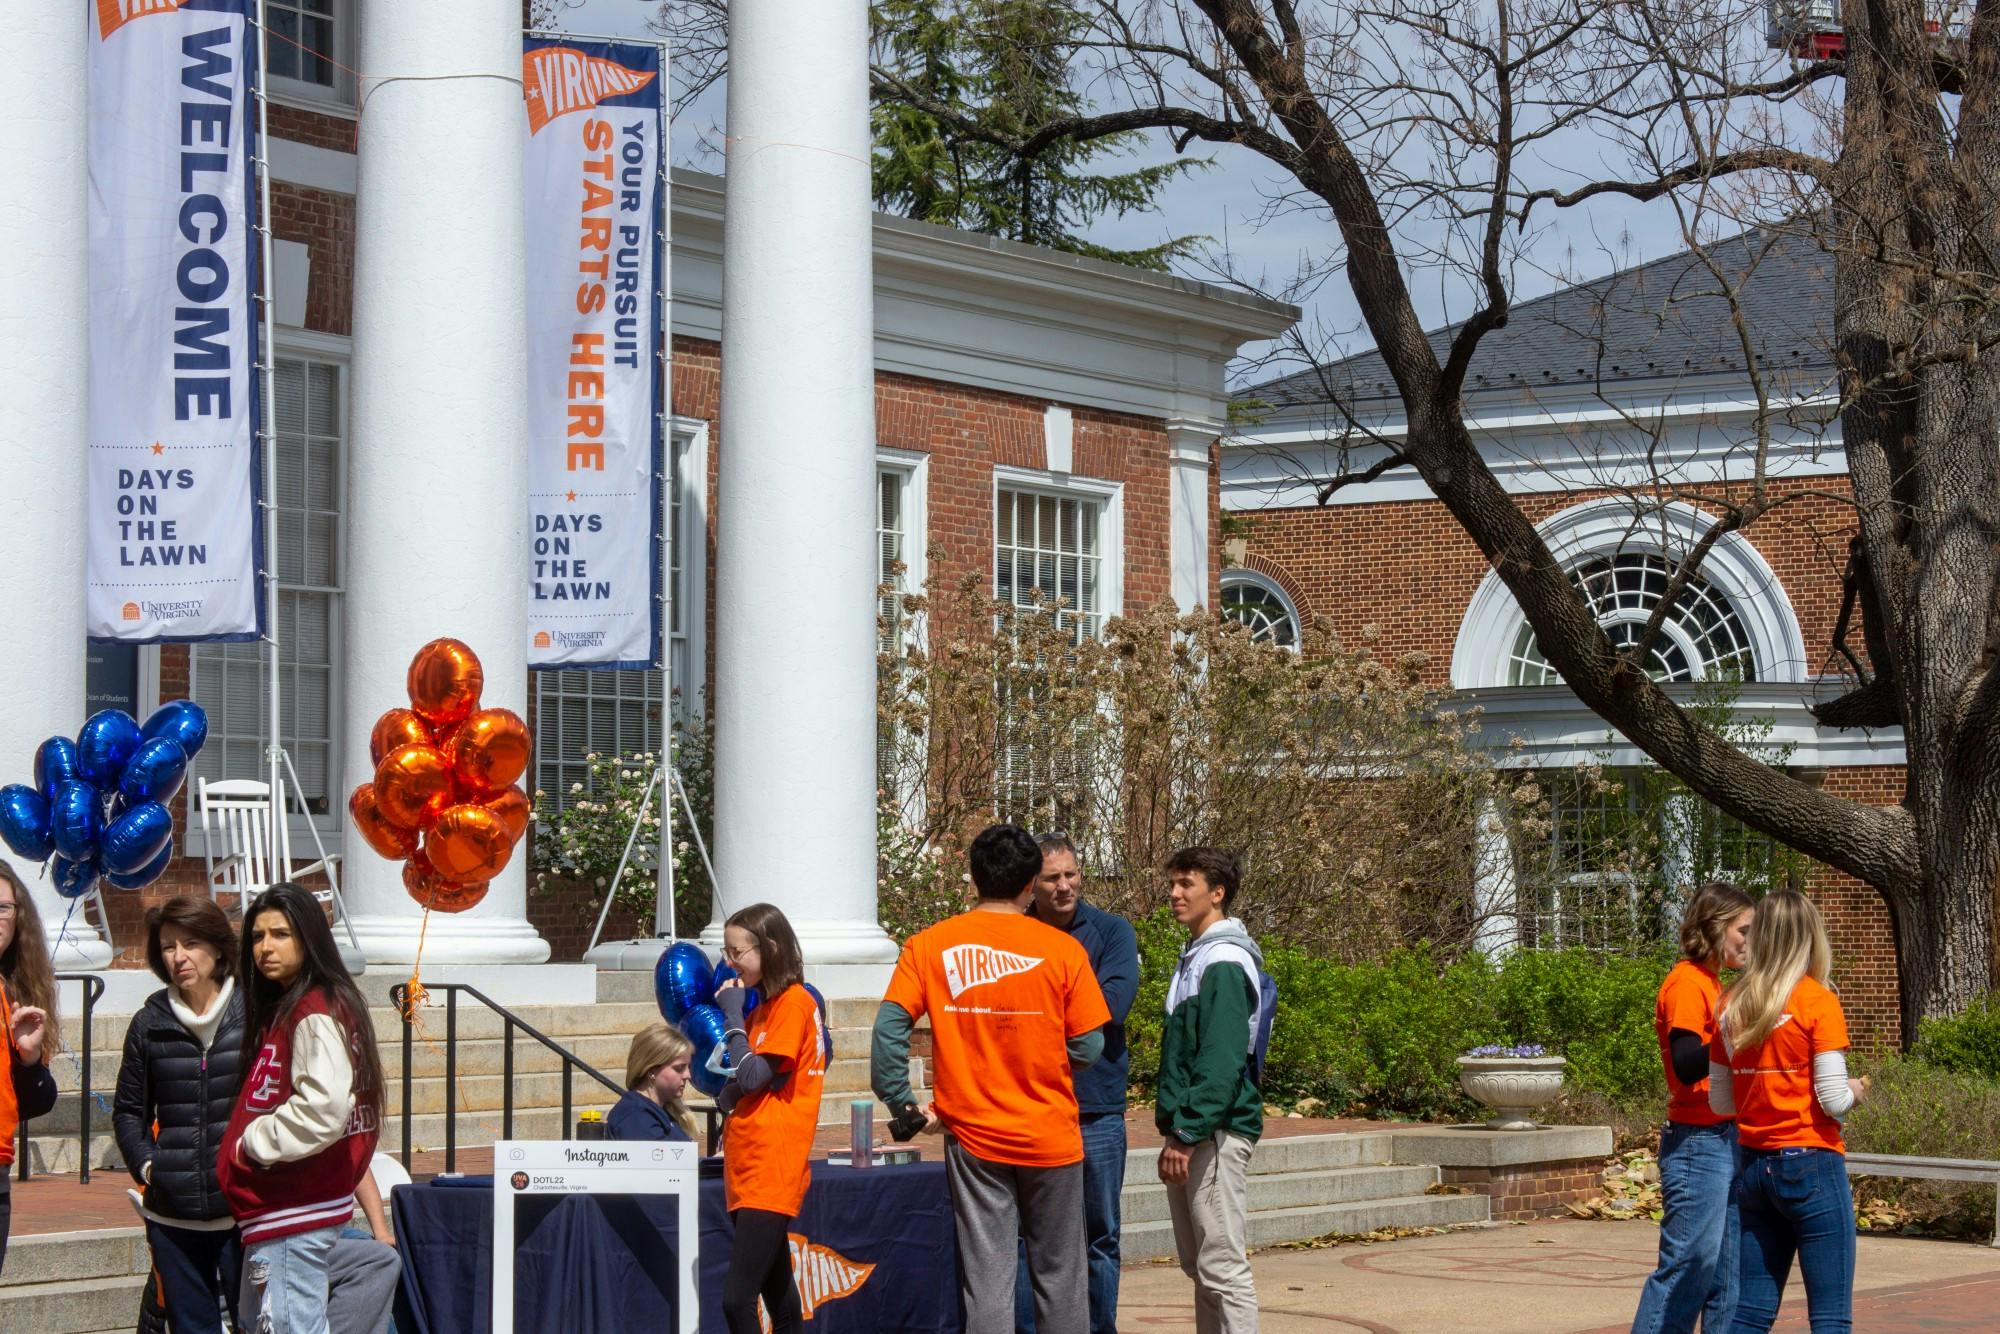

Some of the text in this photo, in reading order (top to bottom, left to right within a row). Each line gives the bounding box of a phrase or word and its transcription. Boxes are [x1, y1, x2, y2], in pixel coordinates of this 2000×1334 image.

[534, 53, 646, 118] VIRGINIA
[174, 26, 232, 421] WELCOME
[614, 120, 644, 369] YOUR PURSUIT
[567, 118, 614, 471] STARTS HERE
[118, 469, 194, 489] DAYS
[117, 495, 157, 515] ON
[118, 520, 177, 541] THE
[535, 514, 603, 533] DAYS
[120, 544, 207, 566] LAWN
[534, 537, 570, 555] ON
[535, 560, 586, 578] THE
[535, 582, 610, 600] LAWN
[141, 600, 203, 613] UNIVERSITY
[153, 609, 201, 621] VIRGINIA
[552, 631, 607, 641] UNIVERSITY
[563, 638, 603, 649] VIRGINIA
[953, 948, 1037, 988] VIRGINIA
[564, 1148, 630, 1167] Instagram
[533, 1176, 564, 1184] DOTL22
